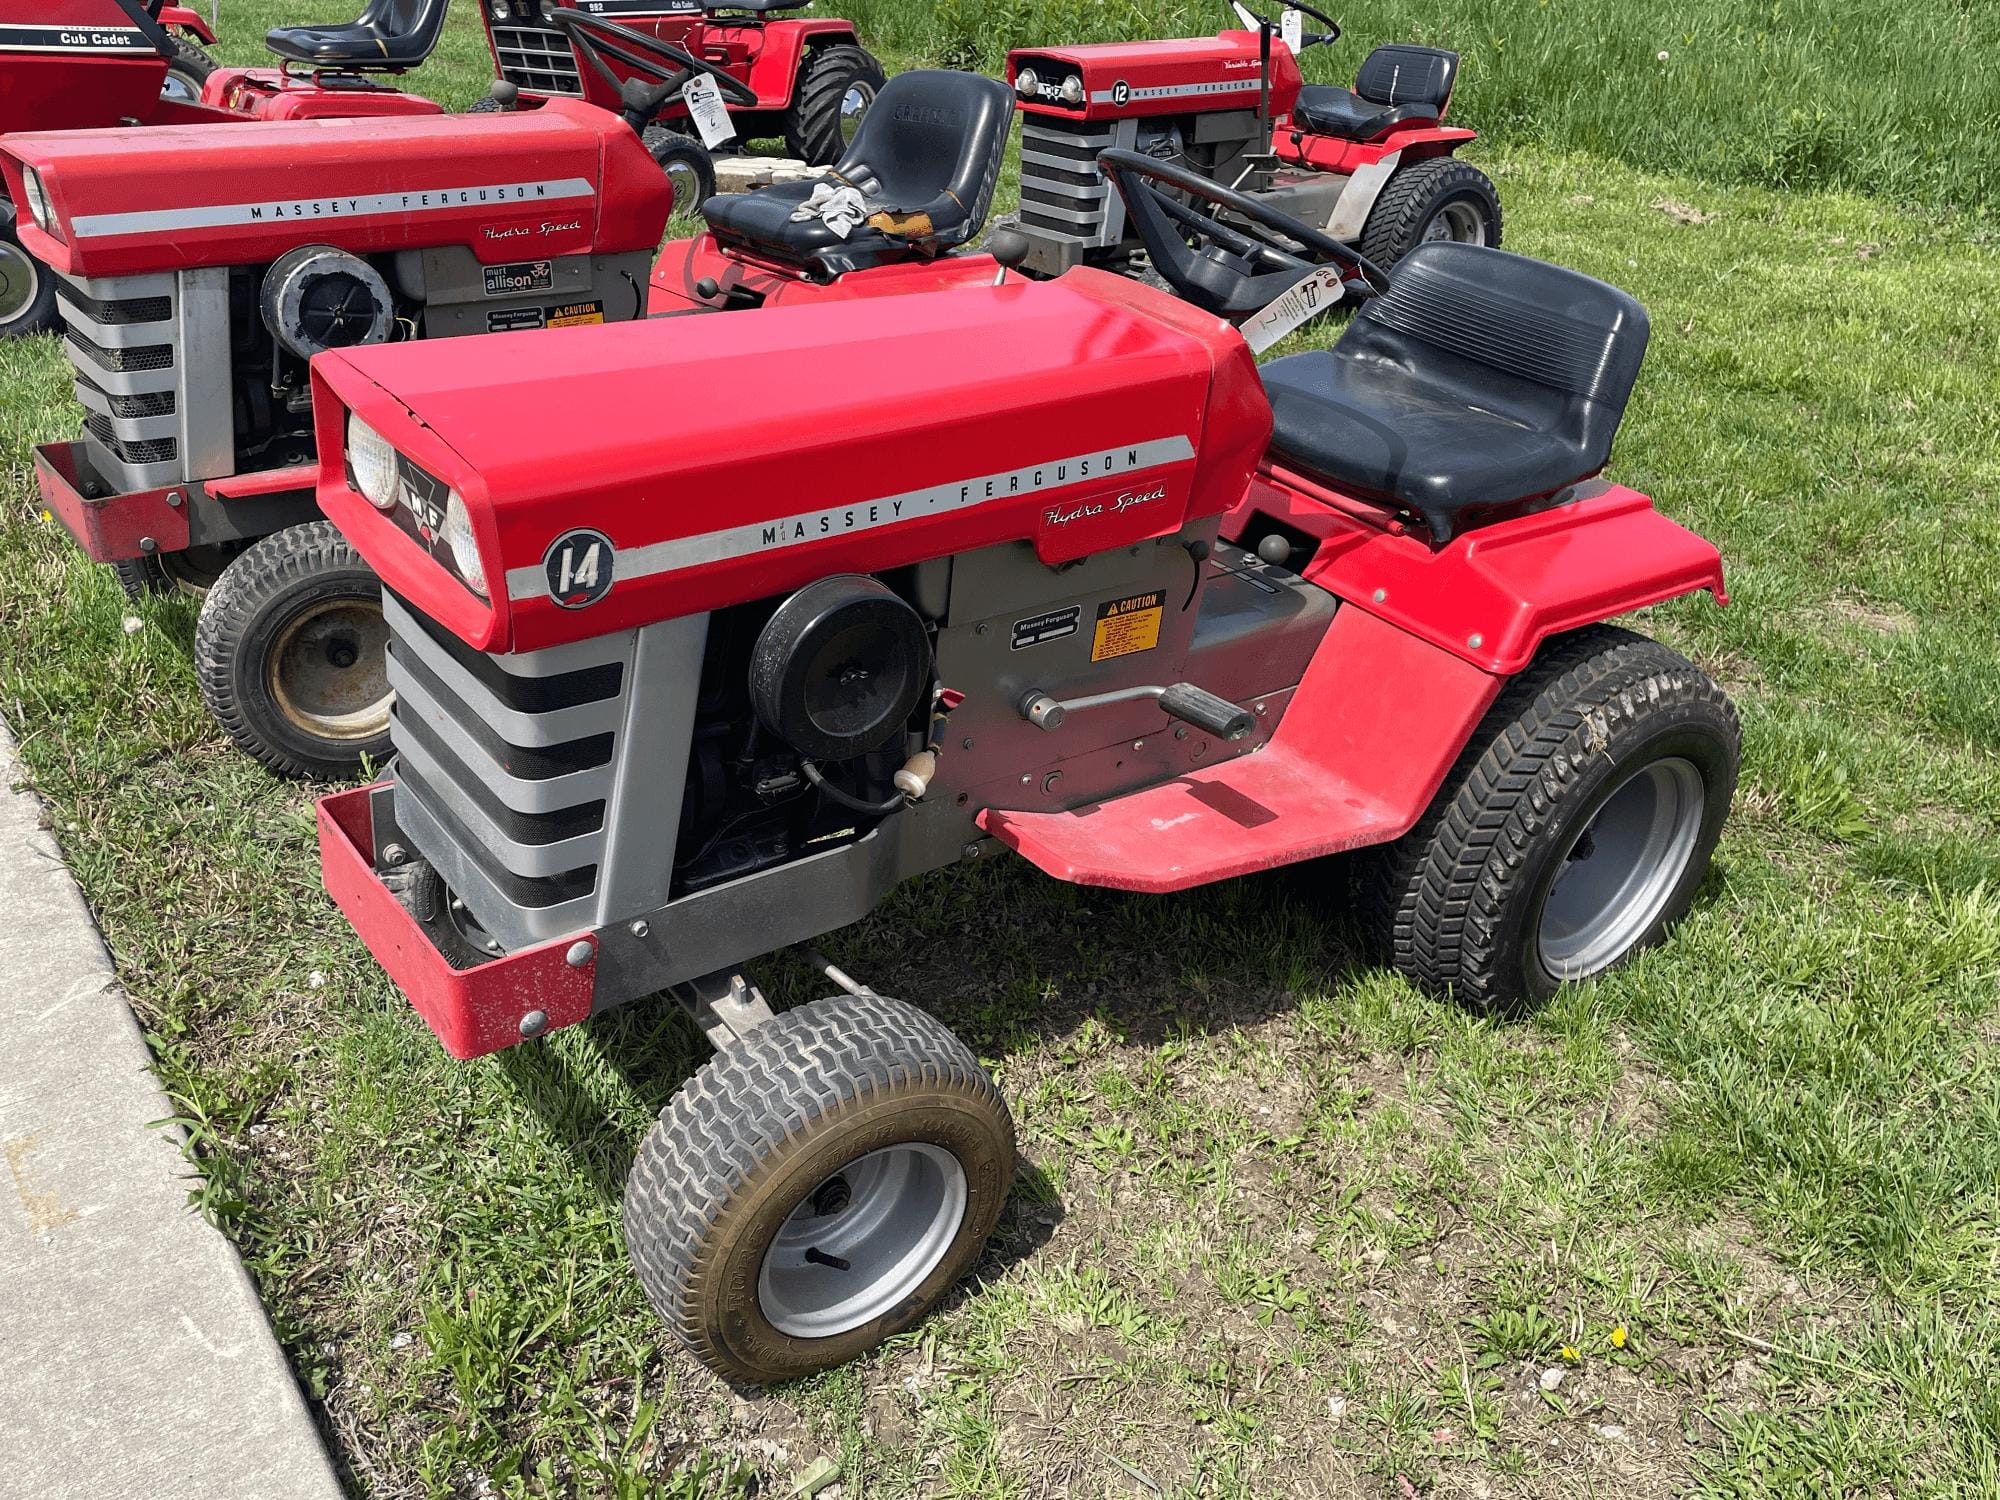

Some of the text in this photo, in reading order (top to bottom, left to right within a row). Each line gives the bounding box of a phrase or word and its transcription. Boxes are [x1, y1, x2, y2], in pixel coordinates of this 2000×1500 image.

[589, 3, 604, 12] 982
[60, 32, 130, 45] Cub Cadet
[1115, 85, 1127, 102] 12
[1135, 87, 1179, 97] MASSEY
[1197, 81, 1253, 93] FERGUSON
[252, 201, 357, 219] MASSEY
[402, 185, 545, 207] FERGUSON
[484, 220, 581, 241] Hydra Speed
[486, 267, 506, 277] murt
[486, 275, 532, 290] allison
[564, 303, 596, 316] CAUTION
[762, 501, 904, 545] MASSEY
[960, 450, 1137, 503] FERGUSON
[1045, 485, 1166, 529] Hydra Speed
[559, 541, 601, 594] 14
[1120, 594, 1157, 613] CAUTION
[1020, 611, 1074, 632] Massey Ferguson
